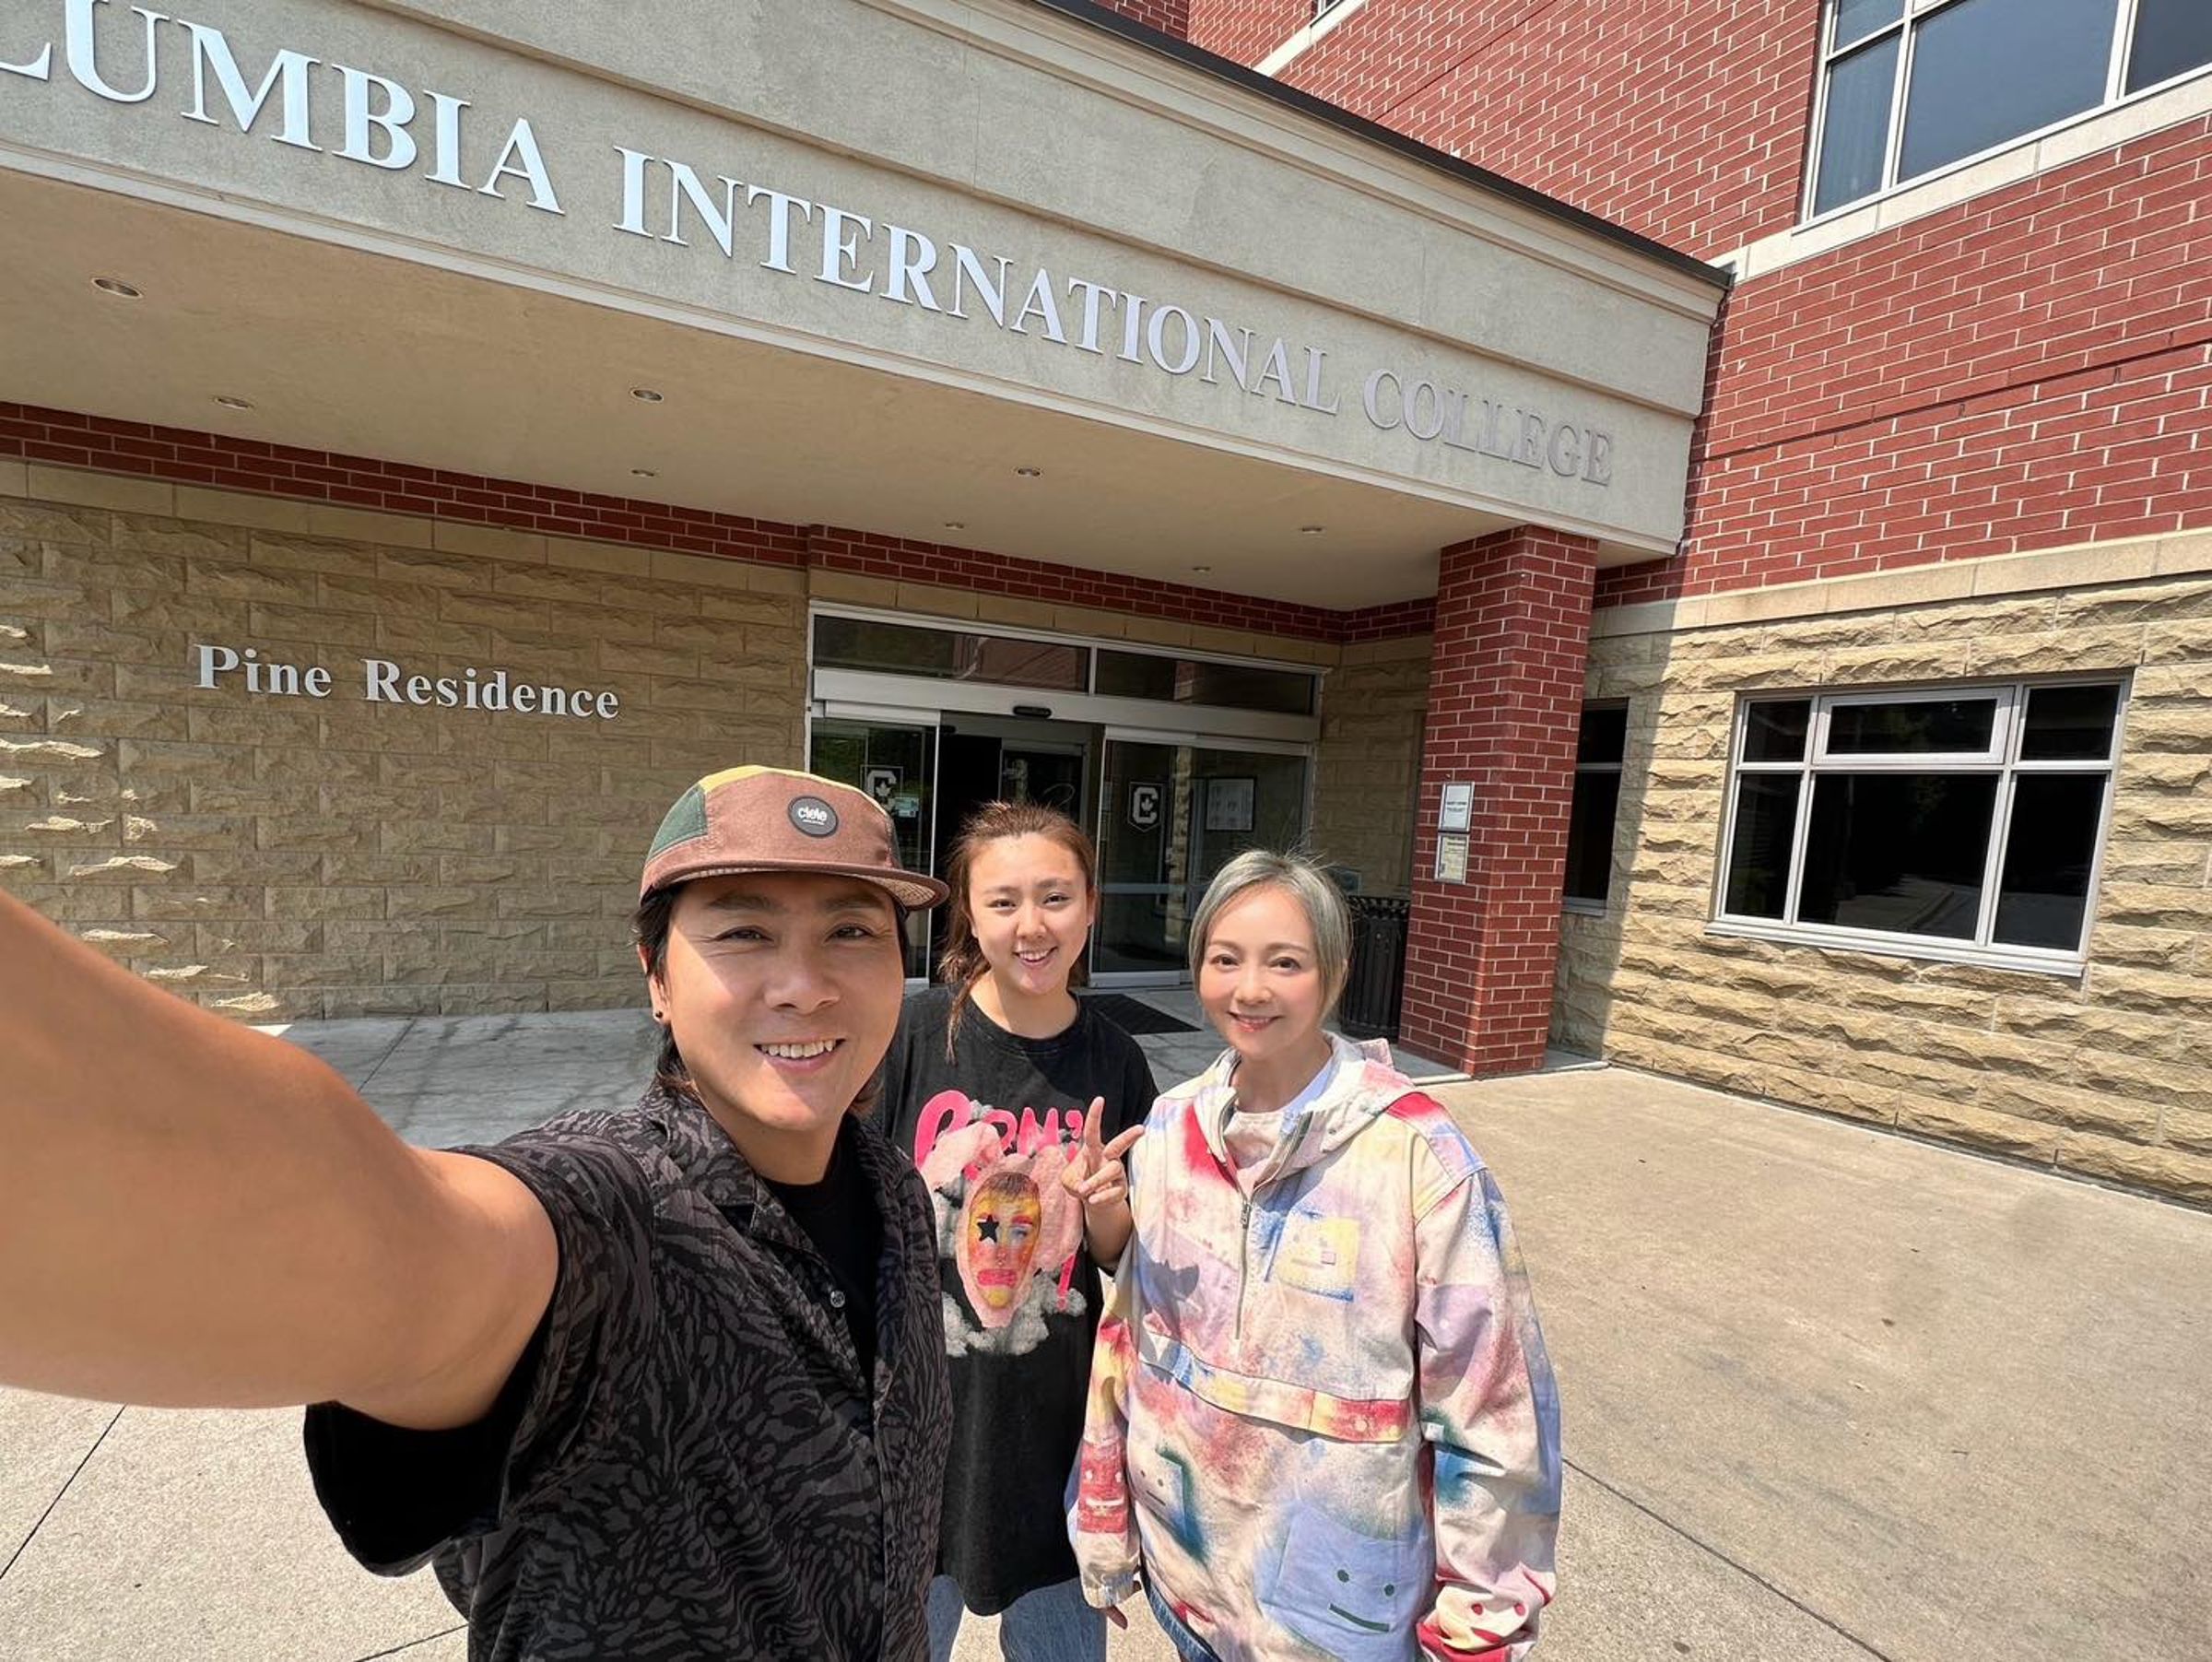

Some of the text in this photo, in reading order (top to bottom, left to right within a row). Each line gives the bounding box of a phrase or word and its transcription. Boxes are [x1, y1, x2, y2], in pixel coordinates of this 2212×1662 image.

[612, 145, 1340, 415] INTERNATIONAL
[1362, 369, 1612, 487] COLLEGE
[194, 643, 620, 719] Pine Residence
